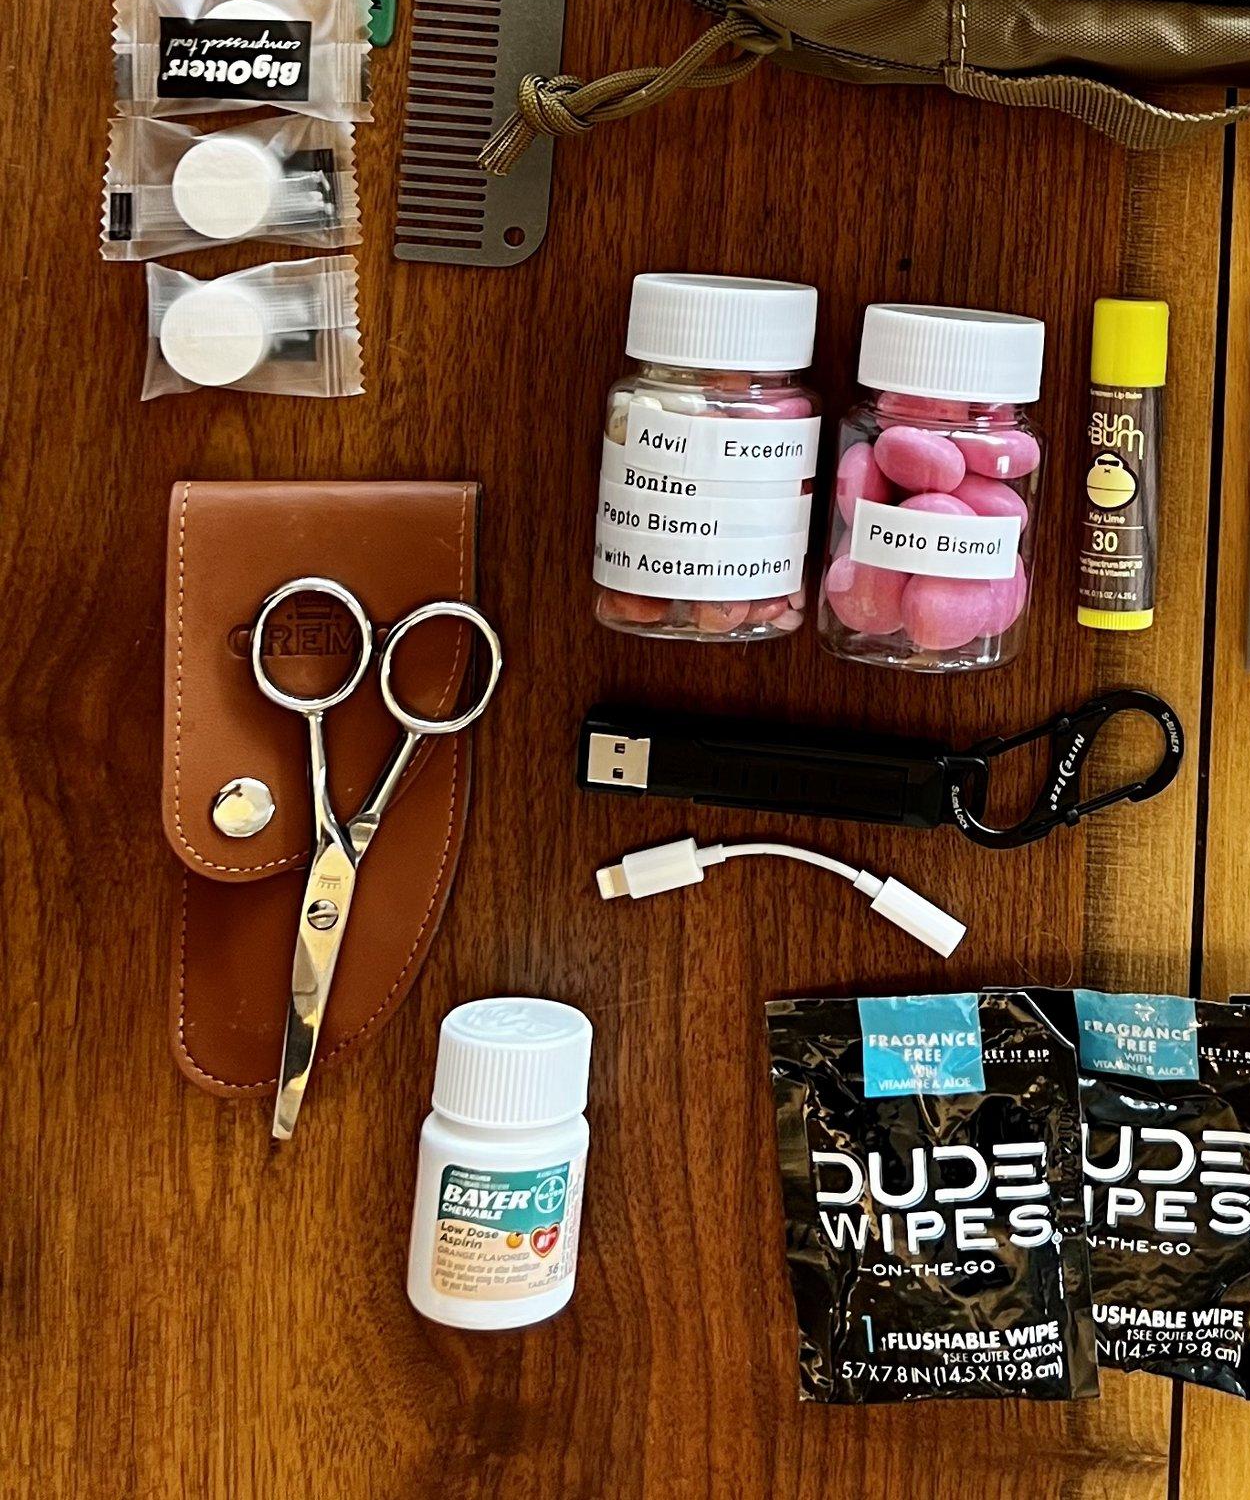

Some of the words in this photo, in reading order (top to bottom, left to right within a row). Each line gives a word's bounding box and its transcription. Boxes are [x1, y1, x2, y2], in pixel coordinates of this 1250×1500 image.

[201, 30, 301, 55] compressed
[168, 54, 302, 88] BigOtters
[638, 427, 687, 454] Advil
[724, 440, 804, 459] Excedrin
[624, 467, 697, 497] Bonine
[603, 501, 640, 527] Pepto
[647, 512, 719, 536] Bismol
[1088, 512, 1103, 524] Key
[1103, 513, 1126, 524] Lime
[869, 524, 928, 550] Pepto
[936, 535, 1002, 556] Bismol
[1092, 530, 1119, 552] 30
[604, 549, 631, 568] with
[637, 553, 791, 578] Acetaminophen
[869, 1032, 977, 1047] FRAGRANCE
[903, 1048, 942, 1062] FREE
[811, 1142, 1051, 1208] DUDE
[442, 1184, 531, 1211] BAYER
[439, 1232, 483, 1250] Aspirin
[440, 1221, 463, 1236] Low
[465, 1226, 499, 1240] Dose
[818, 1203, 1056, 1254] WIPES
[872, 1260, 997, 1277] ON-THE-GO
[887, 1331, 1001, 1351] FLUSHABLE
[1006, 1321, 1060, 1346] WIPE
[971, 1350, 1010, 1363] OUTER
[1014, 1341, 1064, 1362] CARTON
